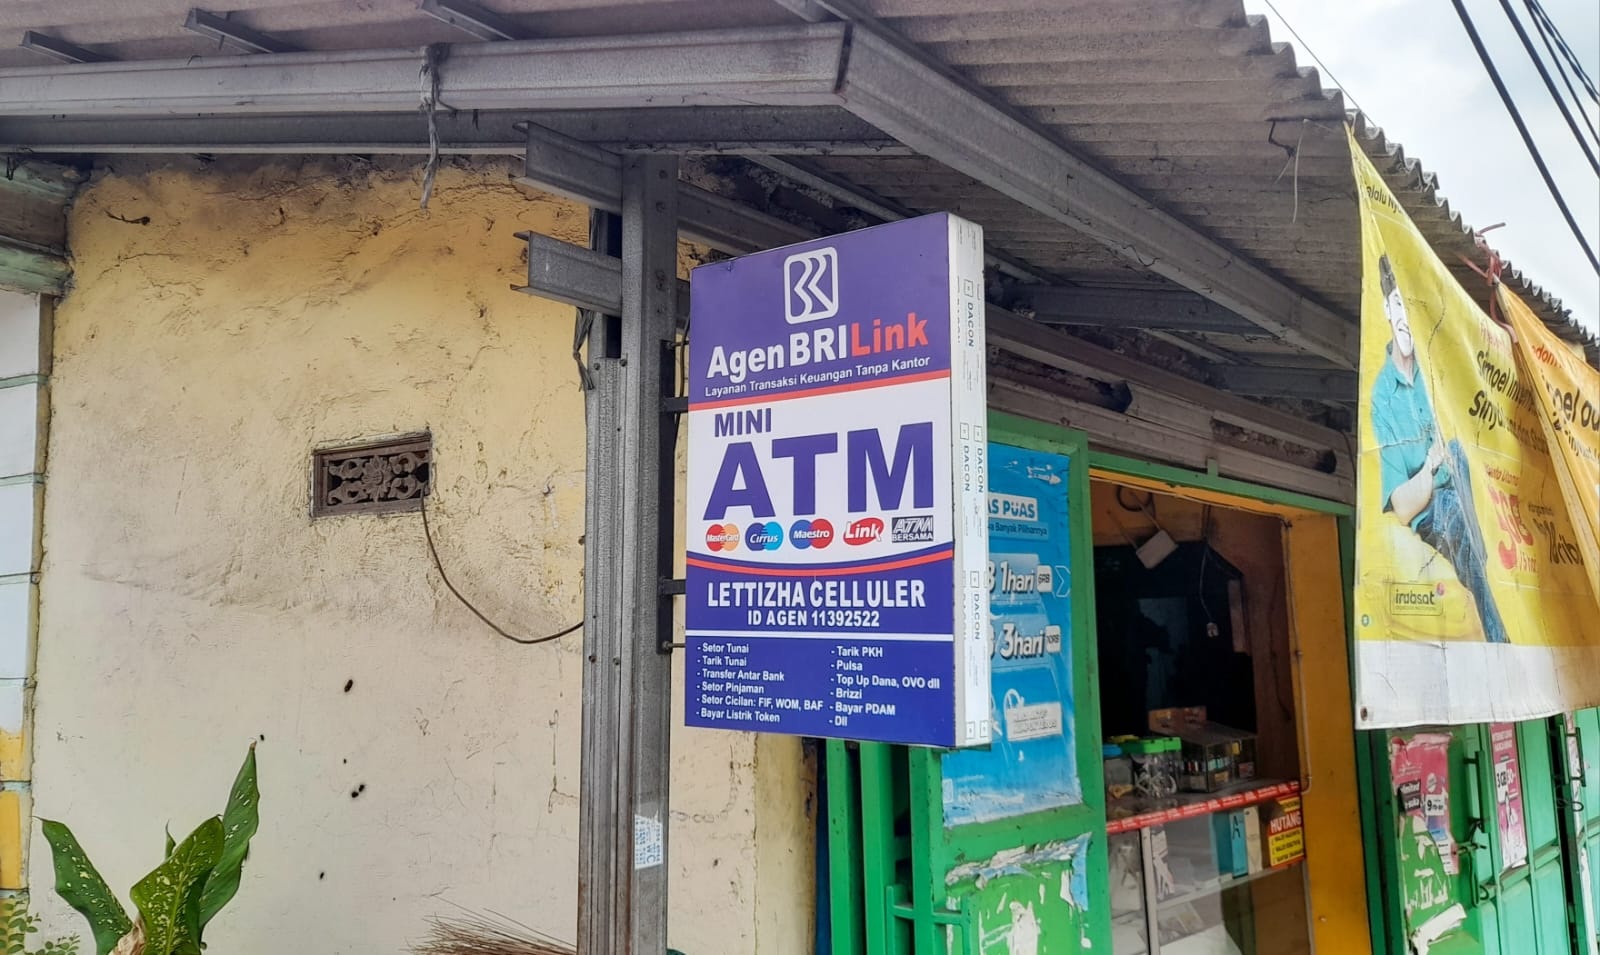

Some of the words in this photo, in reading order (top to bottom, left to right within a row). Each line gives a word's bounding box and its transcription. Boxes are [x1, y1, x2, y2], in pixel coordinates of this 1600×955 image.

[705, 385, 747, 397] Layanan
[750, 377, 797, 391] Transaksi
[800, 369, 852, 385] Keuangan
[856, 363, 888, 378] Tanpa
[892, 355, 930, 371] Kantor
[715, 408, 771, 438] MINI
[703, 422, 933, 520] ATM
[963, 445, 971, 492] DACON
[845, 521, 882, 542] Link
[893, 517, 932, 534] ATM
[706, 533, 741, 542] MasterCard
[750, 533, 779, 545] Cirrus
[793, 529, 830, 540] Maestro
[892, 533, 934, 542] BERSAMA
[708, 581, 805, 607] LETTIZHA
[809, 580, 926, 608] CELLULER
[748, 611, 762, 625] ID
[766, 611, 807, 626] AGEN
[811, 611, 880, 627] 11392522
[702, 642, 724, 653] Setor
[726, 643, 749, 653] Tunai
[837, 646, 859, 657] Tarik
[862, 647, 883, 657] PKH
[702, 655, 722, 666] Tarik
[724, 656, 747, 667] Tunai
[836, 660, 863, 671] Pulsa
[702, 668, 736, 680] Transfer
[737, 670, 760, 680] Antar
[763, 671, 785, 682] Bank
[836, 673, 854, 687] Top
[856, 674, 870, 688] Up
[872, 675, 899, 689] Dana,
[902, 676, 926, 689] OVO
[927, 678, 940, 689] dll
[702, 681, 724, 692] Setor
[726, 682, 765, 695] Pinjaman
[836, 687, 862, 699] Brizzi
[701, 694, 723, 705] Setor
[725, 695, 756, 707] Cicilan:
[759, 697, 774, 709] FIF,
[776, 698, 802, 711] WOM,
[804, 700, 824, 711] BAF
[835, 701, 863, 715] Bayar
[865, 703, 896, 716] PDAM
[701, 707, 724, 720] Bayar
[726, 710, 752, 720] Listrik
[755, 711, 781, 722] Token
[835, 715, 848, 727] Dll
